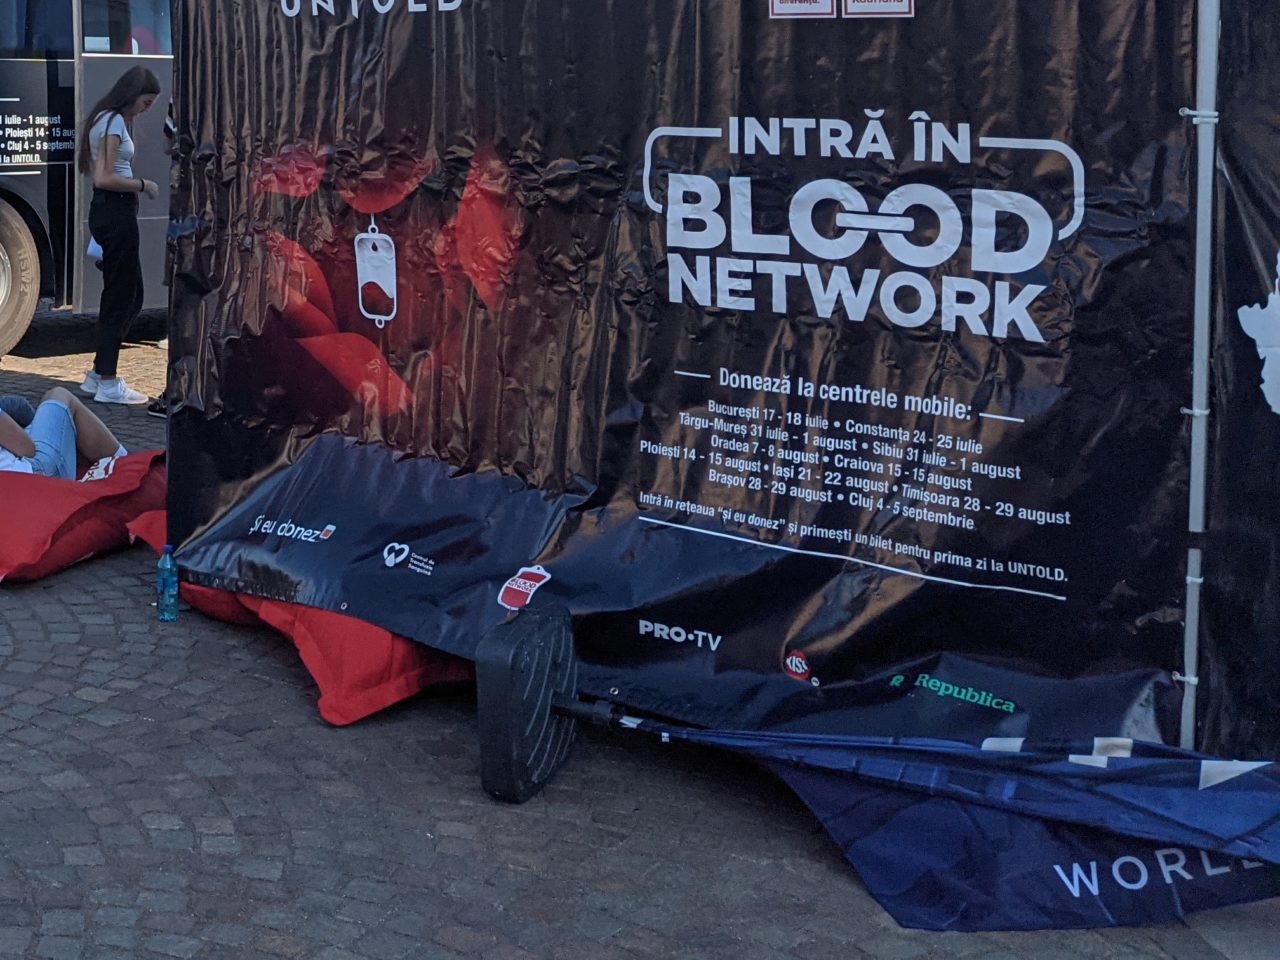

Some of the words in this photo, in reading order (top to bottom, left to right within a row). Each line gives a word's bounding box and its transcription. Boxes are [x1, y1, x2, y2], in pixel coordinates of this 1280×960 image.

[5, 115, 21, 125] iulie
[29, 115, 33, 124] 1
[35, 115, 61, 126] august
[5, 128, 33, 139] Ploiești
[35, 128, 44, 137] 14
[52, 128, 61, 136] 15
[63, 130, 76, 138] aug
[7, 141, 22, 152] Cluj
[24, 141, 29, 150] 4
[36, 141, 41, 150] 5
[43, 141, 74, 152] septemb
[728, 108, 895, 160] INTRĂ
[908, 110, 971, 164] ÎN
[3, 155, 10, 163] la
[12, 154, 42, 163] UNTOLD.
[665, 172, 1054, 274] BLOOD
[666, 252, 1048, 343] NETWORK
[719, 367, 790, 395] Donează
[798, 377, 814, 398] la
[819, 383, 898, 409] centrele
[904, 394, 972, 420] mobile:
[708, 400, 760, 423] București
[763, 408, 775, 421] 17
[786, 412, 801, 425] 18
[806, 414, 828, 430] iulie
[845, 419, 910, 445] Constanța
[913, 430, 926, 443] 24
[937, 435, 952, 449] 25
[956, 438, 983, 454] iulie
[750, 424, 762, 437] 31
[766, 426, 788, 441] iulie
[803, 432, 808, 444] 1
[813, 434, 857, 451] august
[873, 441, 903, 459] Sibiu
[906, 448, 919, 461] 31
[923, 450, 946, 467] iulie
[960, 457, 966, 471] 1
[972, 461, 1021, 480] august
[640, 440, 680, 460] Ploiești
[683, 447, 696, 460] 14
[709, 452, 722, 465] 15
[725, 456, 761, 473] august
[772, 463, 794, 480] Iași
[798, 468, 811, 481] 21
[824, 472, 841, 485] 22
[845, 476, 889, 493] august
[902, 484, 960, 508] Timișoara
[964, 497, 980, 512] 28
[995, 502, 1014, 517] 29
[1018, 506, 1071, 525] august
[711, 435, 749, 452] Oradea
[752, 442, 758, 454] 7
[768, 445, 774, 457] 8
[777, 449, 819, 466] august
[834, 454, 884, 474] Craiova
[888, 463, 901, 477] 15
[912, 468, 924, 482] 15
[927, 473, 972, 491] august
[708, 469, 746, 488] Brașov
[748, 476, 761, 490] 28
[771, 481, 786, 495] 29
[790, 486, 832, 503] august
[849, 493, 874, 511] Cluj
[876, 498, 883, 511] 4
[893, 502, 899, 515] 5
[902, 504, 974, 530] septembrie
[261, 521, 277, 533] eu
[277, 519, 321, 542] donez
[639, 491, 662, 506] Intră
[664, 494, 673, 508] în
[734, 511, 746, 523] eu
[855, 533, 868, 545] un
[869, 533, 892, 551] bilet
[895, 542, 930, 559] pentru
[934, 551, 972, 568] prima
[976, 558, 987, 571] zi
[991, 559, 1004, 572] la
[1008, 561, 1068, 582] UNTOLD.
[914, 673, 1015, 712] Republica
